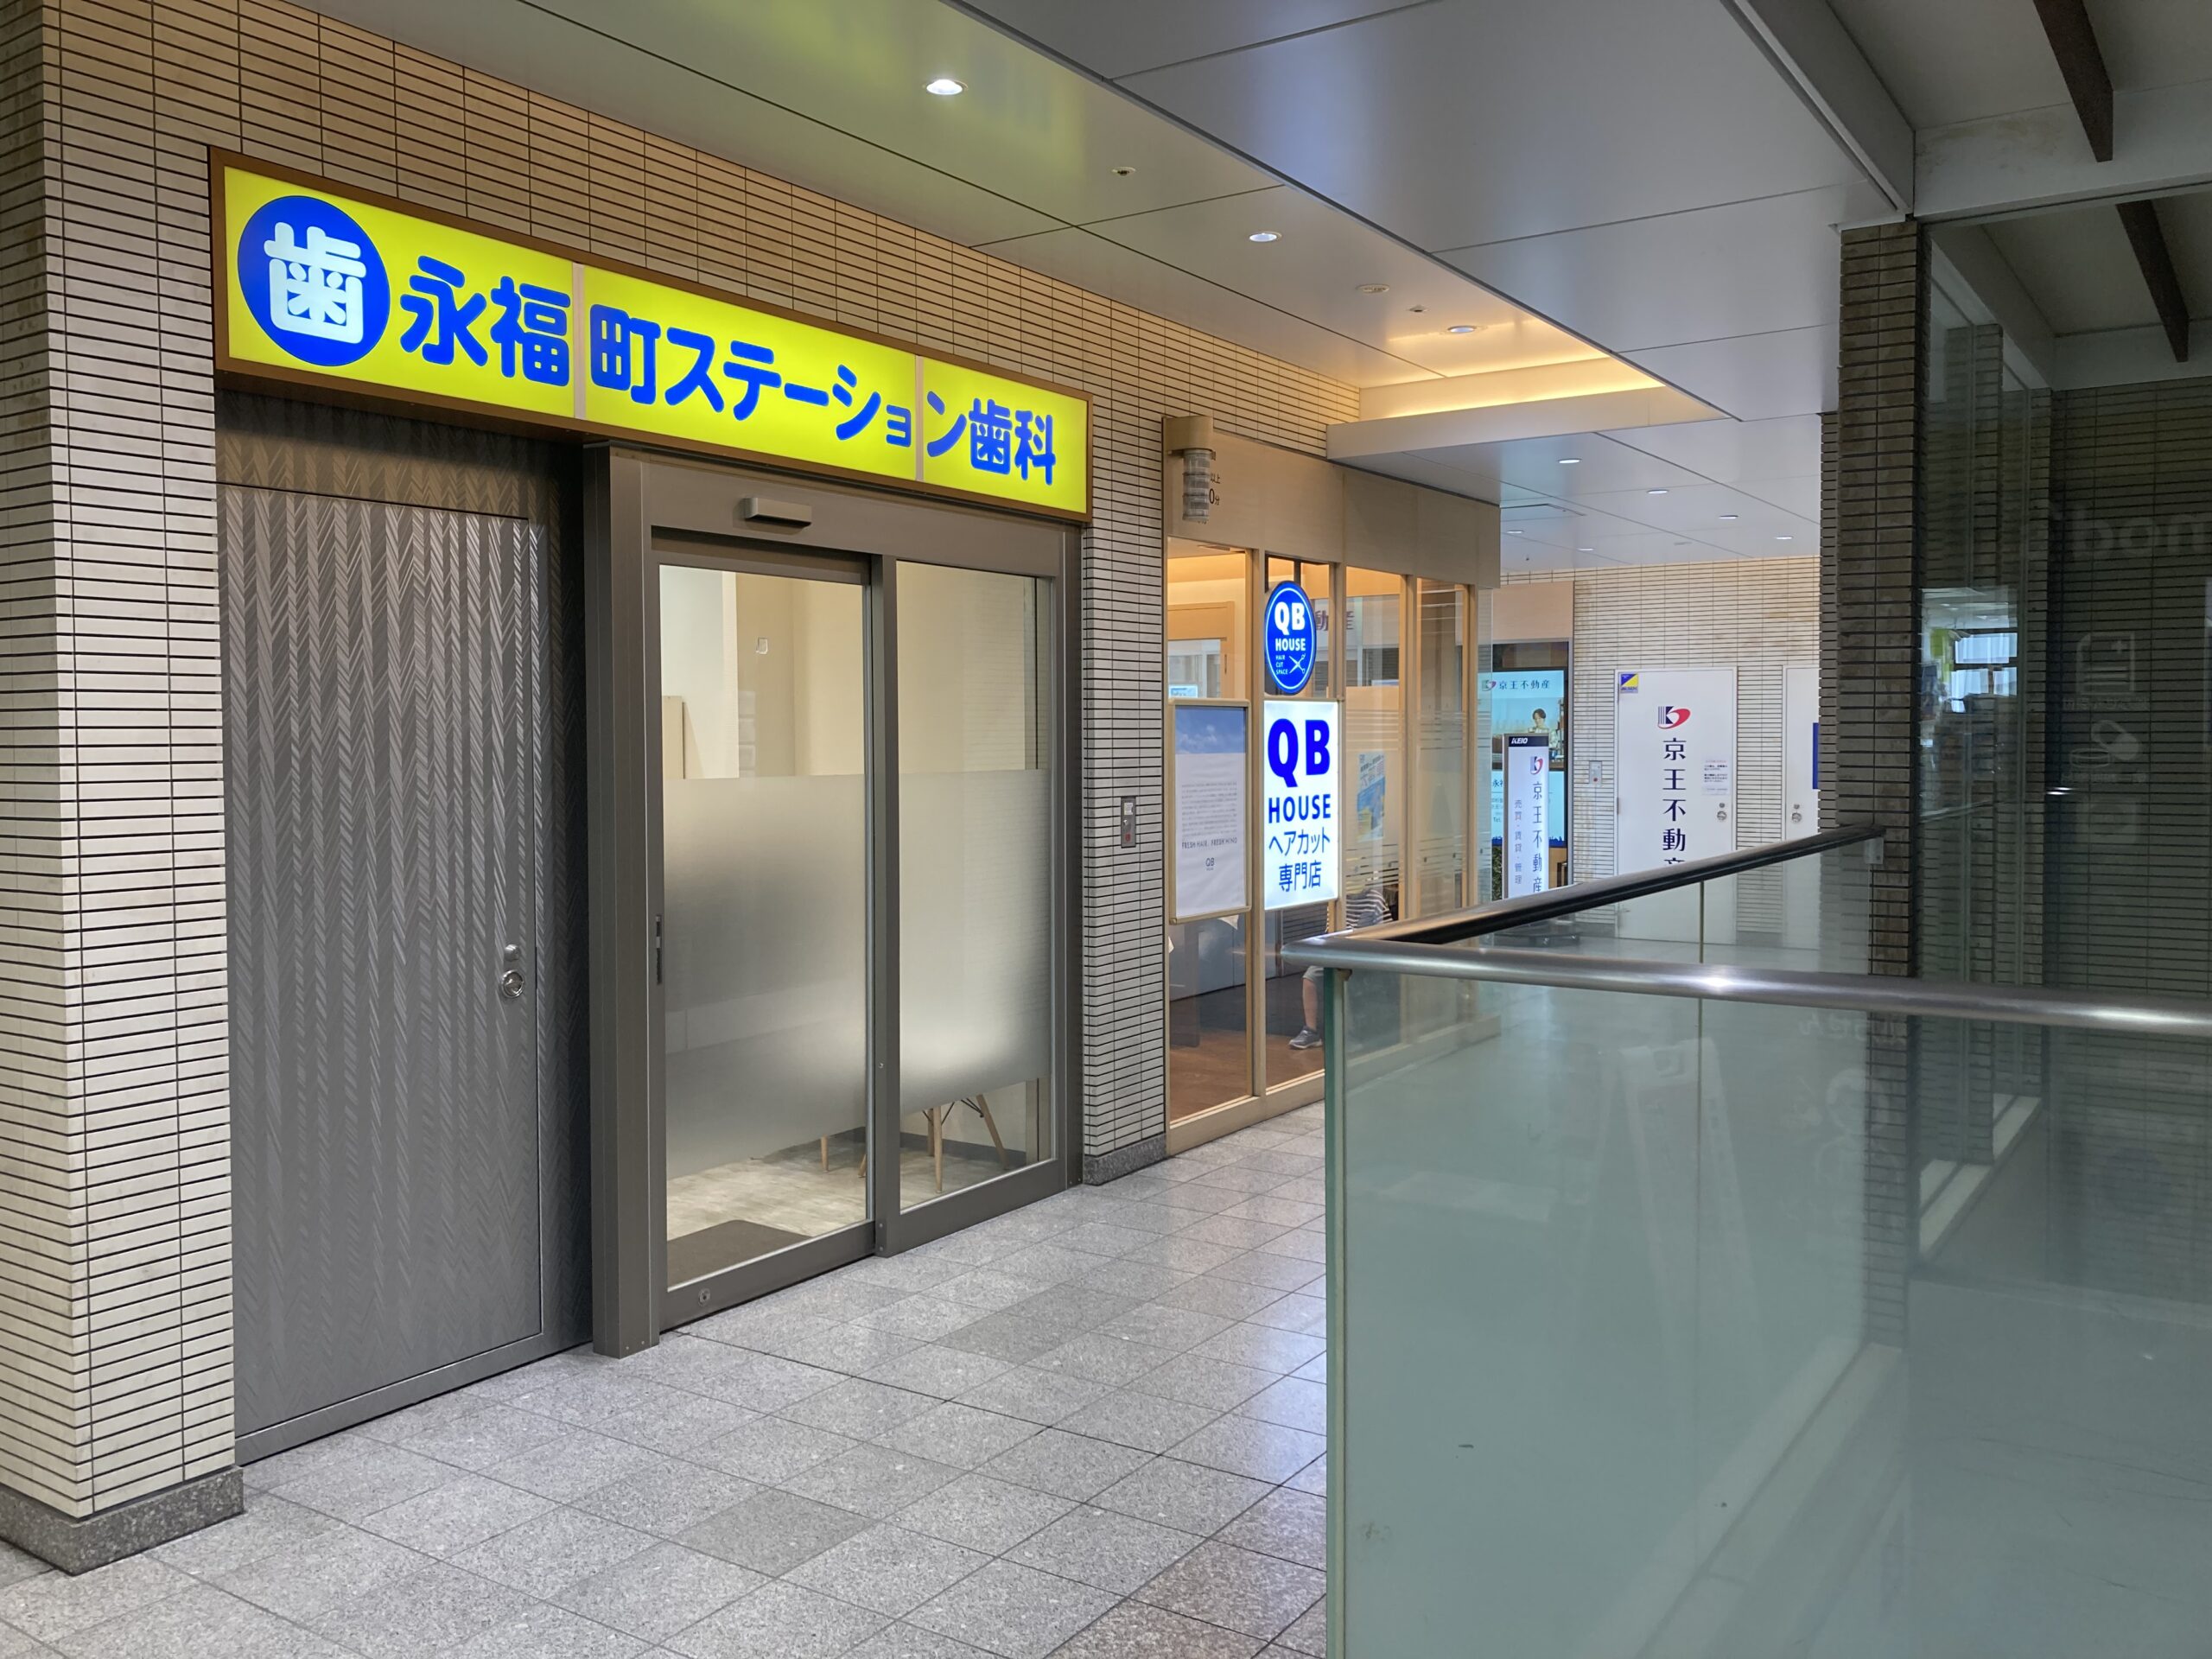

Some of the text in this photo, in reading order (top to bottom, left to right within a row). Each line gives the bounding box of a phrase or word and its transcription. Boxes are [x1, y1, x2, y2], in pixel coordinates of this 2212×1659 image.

[263, 221, 1057, 486] 歯 永福町ステーション歯科
[1274, 601, 1306, 635] QB
[1275, 638, 1306, 652] HOUSE
[1499, 679, 1550, 690] 京王不動産
[1268, 718, 1331, 787] QB
[1268, 793, 1332, 823] HOUSE
[1268, 826, 1331, 857] ヘアカット
[1205, 857, 1215, 867] QB
[1279, 861, 1322, 892] 専門店
